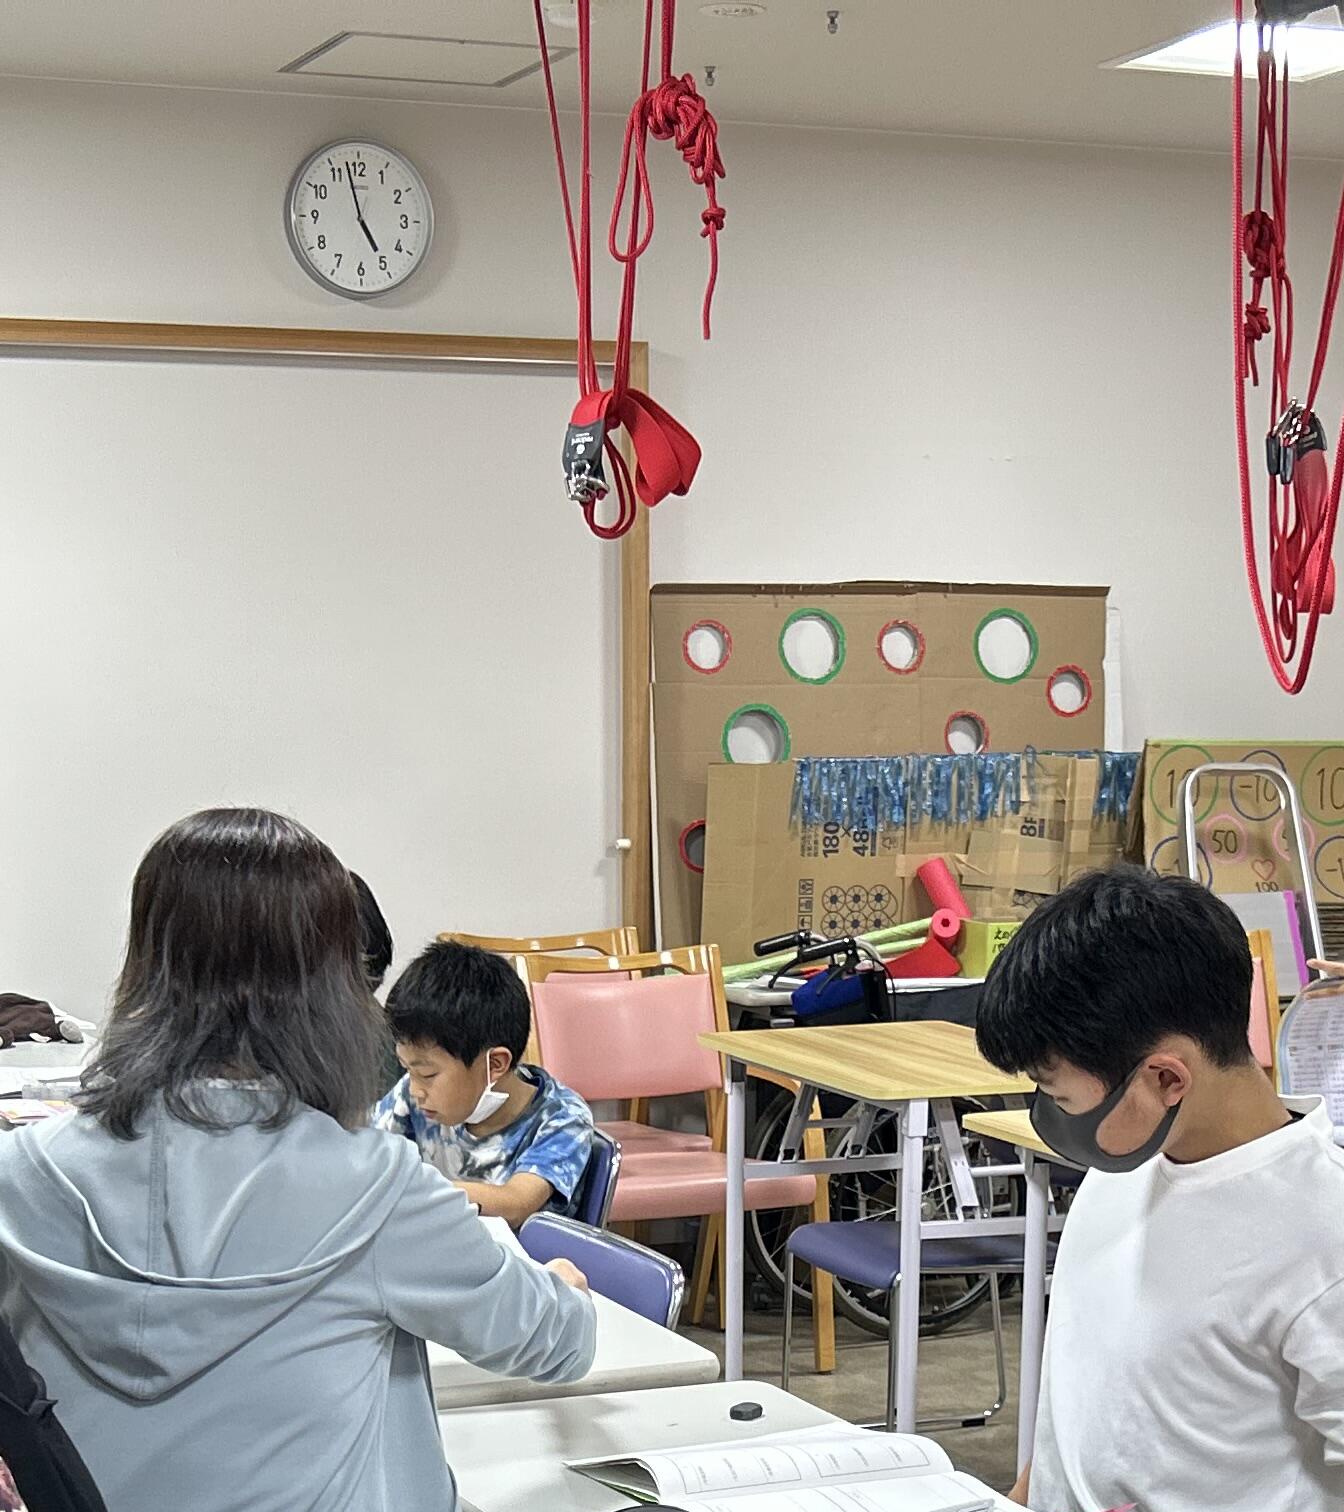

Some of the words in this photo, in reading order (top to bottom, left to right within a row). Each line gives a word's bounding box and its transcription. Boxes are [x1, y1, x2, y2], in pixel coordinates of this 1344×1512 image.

[330, 167, 343, 182] 11
[351, 162, 366, 177] 12
[378, 170, 385, 185] 1
[313, 184, 327, 200] 10
[393, 189, 402, 204] 2
[311, 209, 319, 224] 9
[400, 215, 409, 229] 3
[317, 235, 326, 250] 8
[395, 239, 403, 253] 4
[334, 254, 343, 268] 7
[357, 261, 365, 276] 6
[379, 256, 387, 270] 5
[823, 821, 840, 859] 180
[1211, 830, 1238, 854] 50
